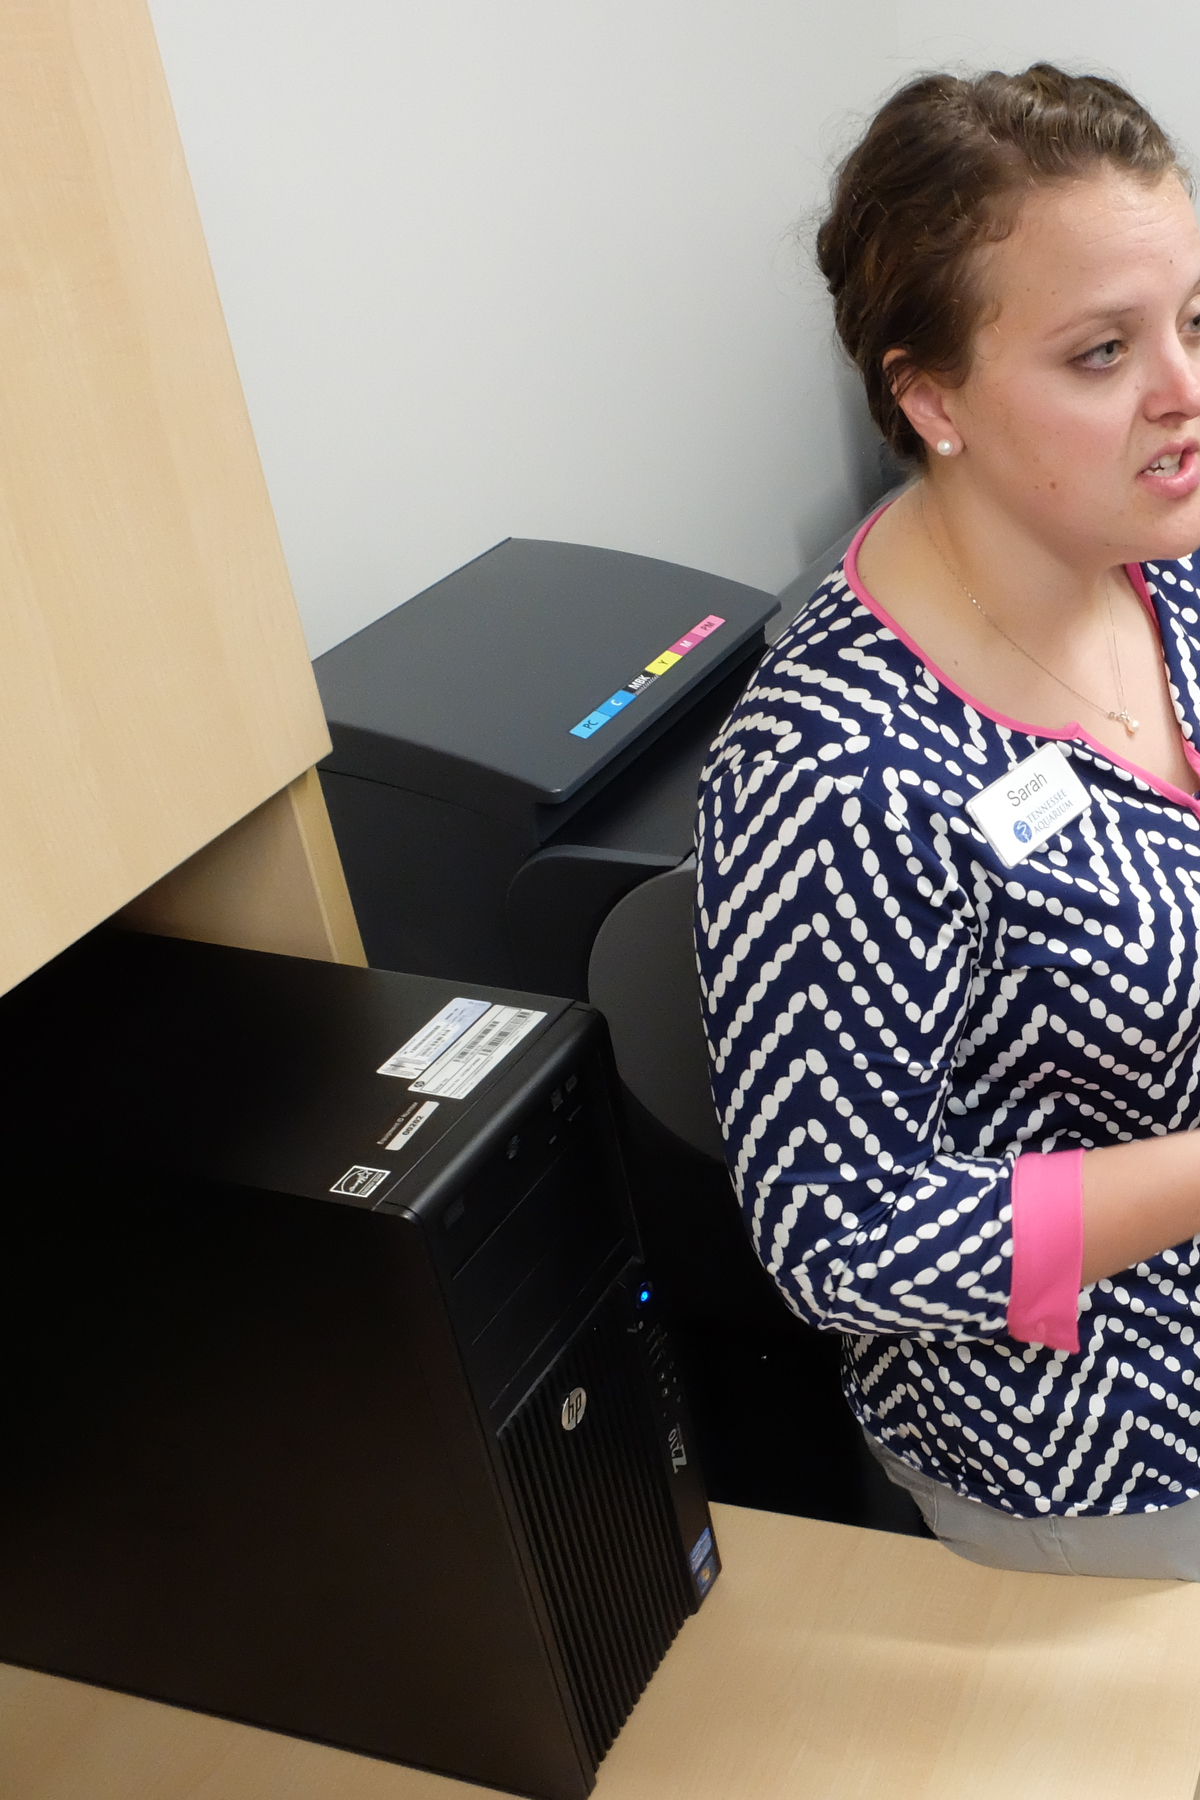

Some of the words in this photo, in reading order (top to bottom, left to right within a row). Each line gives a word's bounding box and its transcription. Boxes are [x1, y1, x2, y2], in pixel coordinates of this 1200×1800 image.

[700, 620, 716, 632] PM
[679, 640, 693, 649] M
[627, 674, 651, 690] MBK
[610, 699, 623, 707] C
[582, 719, 599, 730] PC
[1007, 772, 1048, 807] Sarah
[1025, 788, 1068, 823] TENNESSEE
[1033, 799, 1074, 835] AQUARIUM
[565, 1389, 586, 1428] hp
